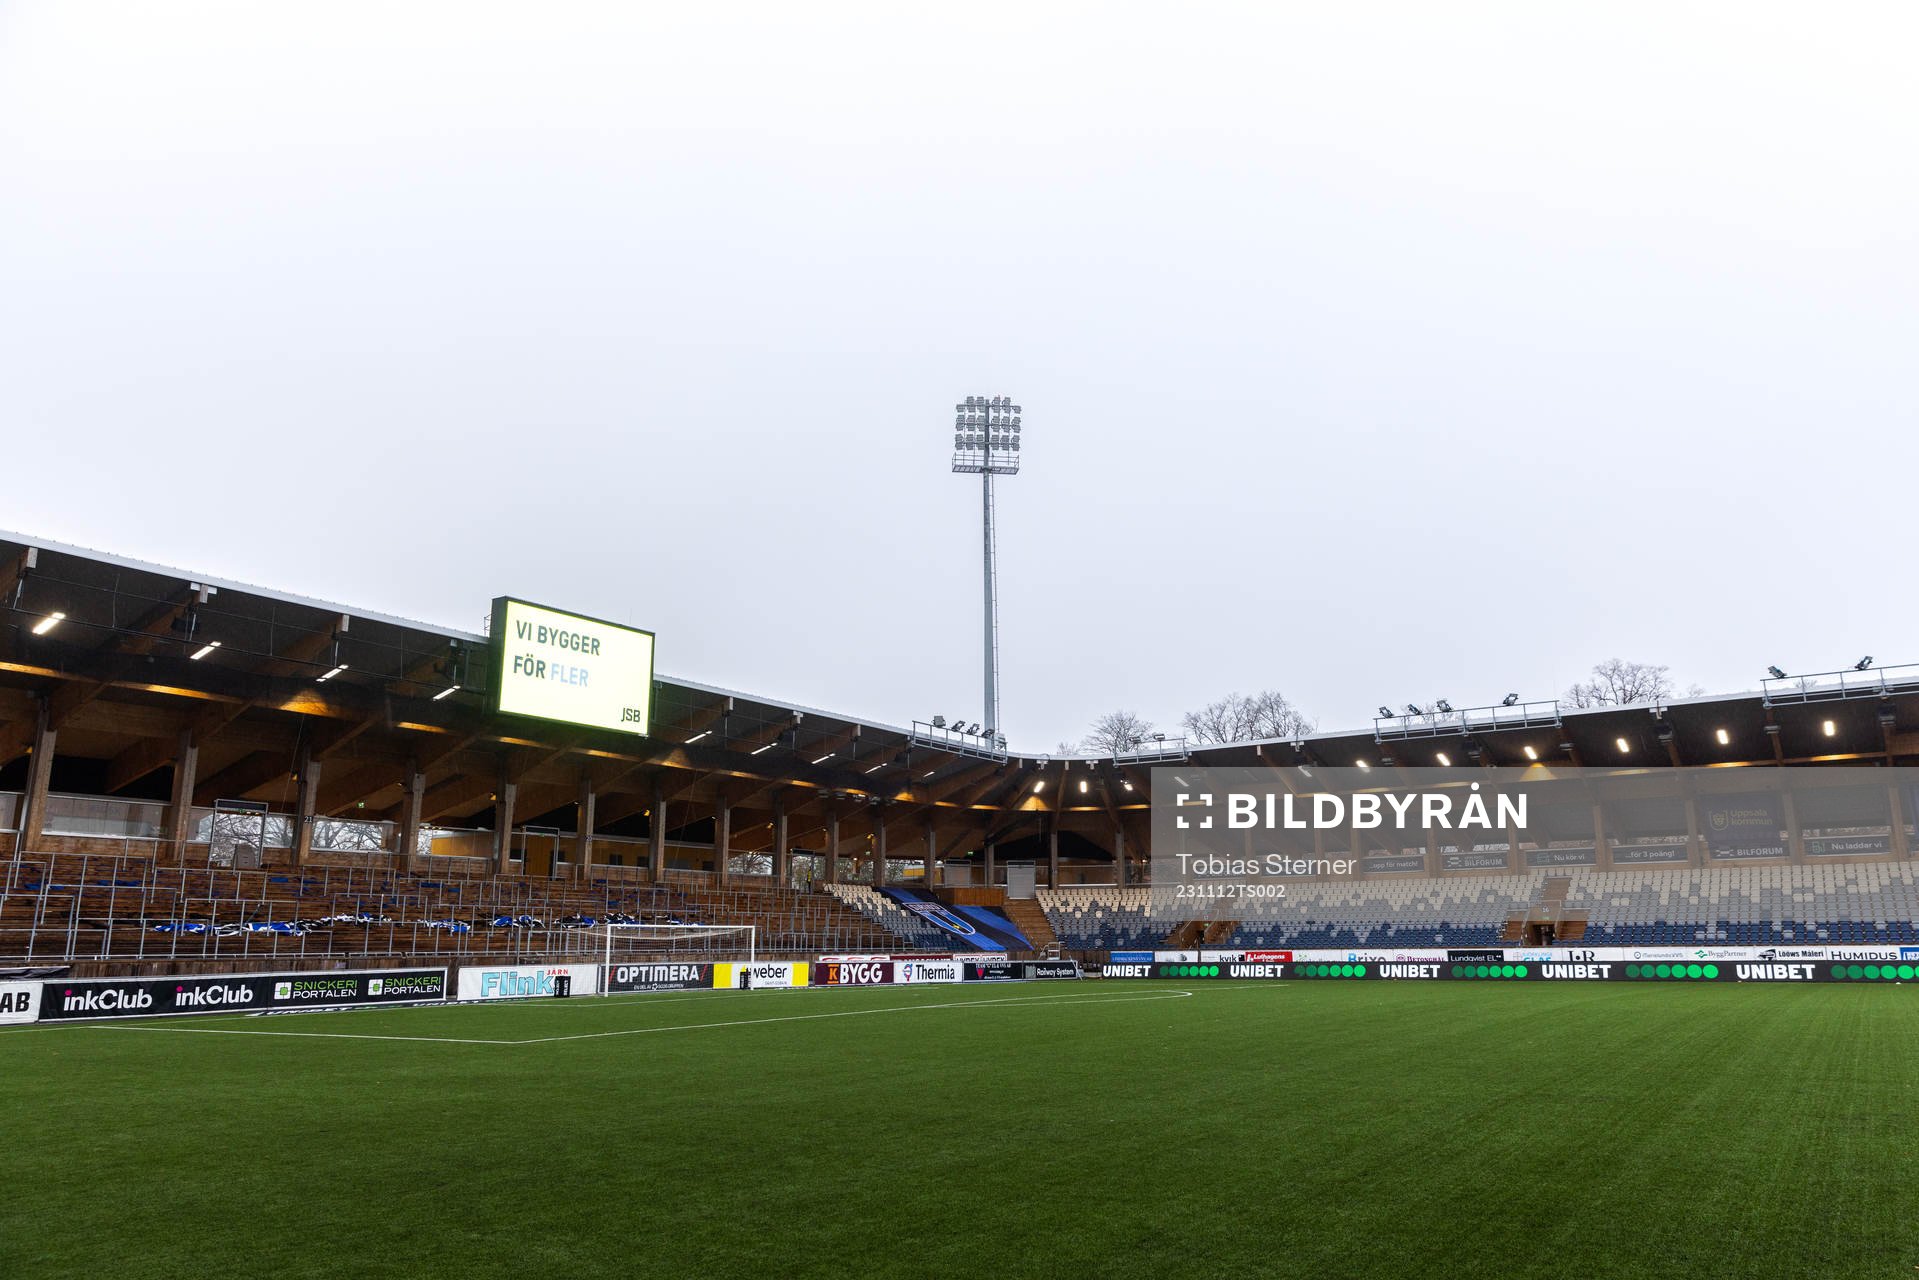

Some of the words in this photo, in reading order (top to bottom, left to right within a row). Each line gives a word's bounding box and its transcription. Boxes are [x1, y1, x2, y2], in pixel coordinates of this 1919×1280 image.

[516, 620, 532, 641] VI
[537, 625, 601, 656] BYGGER
[513, 653, 546, 679] FÖR
[551, 663, 589, 688] FLER
[621, 708, 641, 723] JSB
[1731, 809, 1768, 818] Uppsala
[1731, 817, 1773, 826] kommun
[1737, 847, 1783, 856] BILFORUM
[1831, 843, 1844, 851] Nu
[1845, 842, 1871, 850] laddar
[1873, 840, 1882, 848] vi
[1465, 859, 1503, 867] BILFORUM
[1348, 953, 1386, 962] Brixo
[1708, 950, 1747, 958] ByggPartner
[1831, 951, 1898, 960] HUMIDUS
[617, 965, 699, 983] OPTIMERA
[829, 967, 837, 980] K
[840, 963, 883, 984] BYGG
[916, 964, 955, 980] Thermia
[1056, 967, 1074, 977] System
[1103, 965, 1151, 977] UNIBET
[1230, 964, 1284, 977] UNIBET
[1379, 964, 1440, 978] UNIBET
[1542, 964, 1611, 979] UNIBET
[1736, 964, 1816, 980] UNIBET
[294, 980, 358, 990] SNICKERI
[385, 976, 442, 987] SNICKERI
[481, 971, 554, 997] Flink
[176, 985, 253, 1006] inkClub
[293, 989, 357, 999] PORTALEN
[384, 985, 441, 995] PORTALEN
[0, 992, 31, 1013] AB
[63, 988, 153, 1011] inkClub
